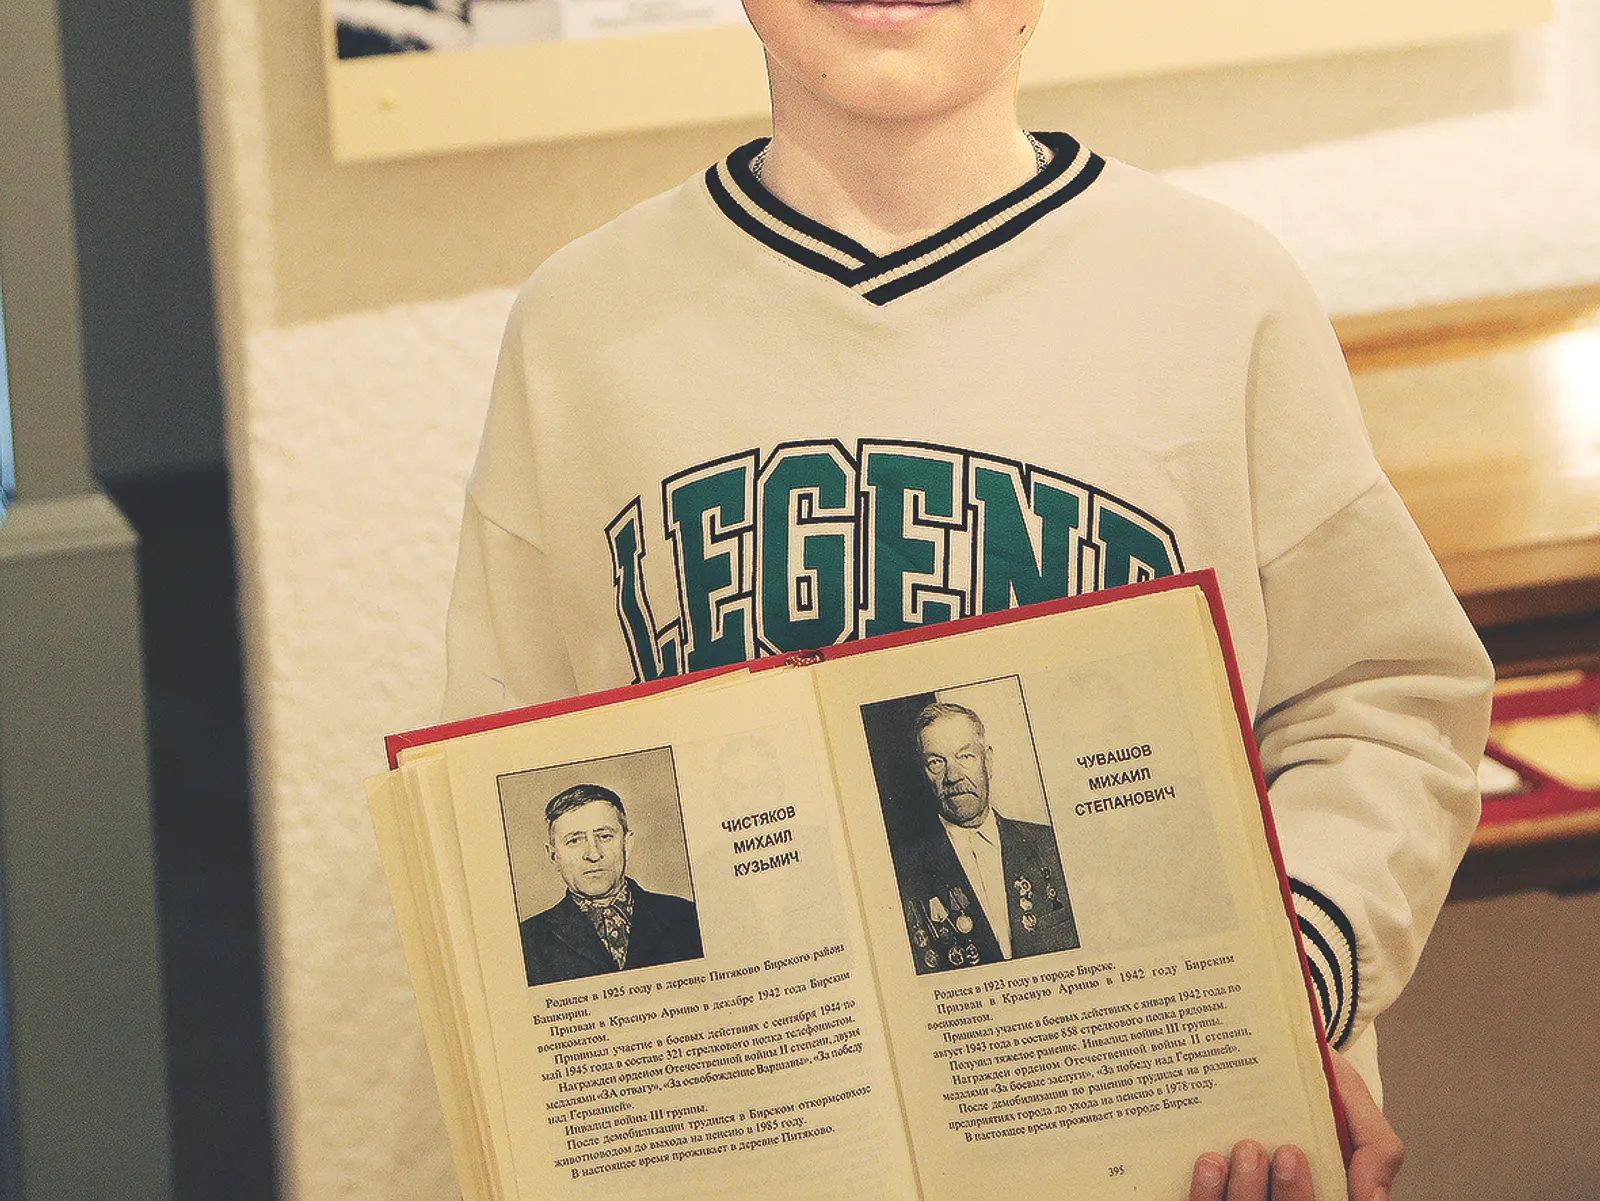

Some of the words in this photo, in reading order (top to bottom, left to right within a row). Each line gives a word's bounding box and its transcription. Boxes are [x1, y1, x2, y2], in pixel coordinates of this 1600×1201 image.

[1076, 744, 1153, 768] ЧУВАШОВ
[1088, 767, 1151, 790] МИХАИЛ
[721, 805, 796, 833] ЧИСТЯКОВ
[1074, 785, 1176, 816] СТЕПАНОВИЧ
[733, 829, 793, 854] МИХАИЛ
[733, 850, 800, 877] КУЗЬМИЧ
[545, 995, 589, 1008] Родился
[602, 986, 625, 999] 1925
[628, 984, 652, 995] году
[663, 976, 706, 989] деревне
[708, 965, 760, 981] Питяково
[763, 953, 810, 971] Бирского
[933, 987, 973, 1000] Родился
[983, 979, 1006, 992] 1923
[1007, 977, 1030, 988] году
[1039, 969, 1075, 983] городе
[1076, 962, 1116, 976] Бирске.
[936, 1000, 985, 1015] Призван
[999, 988, 1052, 1004] Красную
[1058, 980, 1099, 995] Армию
[1120, 969, 1145, 982] 1942
[1151, 965, 1177, 976] году
[1184, 955, 1235, 970] Бирским
[532, 1009, 591, 1025] Башкирии.
[549, 1022, 596, 1037] Призван
[608, 1011, 657, 1027] Красную
[660, 1004, 700, 1018] Армию
[712, 995, 754, 1010] декабре
[757, 987, 781, 1001] 1942
[783, 984, 807, 995] года
[809, 972, 850, 989] Бирским
[943, 1028, 994, 1043] Принимал
[994, 1021, 1034, 1037] участие
[1042, 1013, 1079, 1026] боевых
[1140, 995, 1177, 1009] января
[1178, 988, 1201, 1002] 1942
[1202, 987, 1227, 997] года
[1227, 984, 1242, 993] по
[553, 1048, 609, 1065] Принимал
[612, 1041, 655, 1057] участие
[663, 1032, 705, 1045] боевых
[770, 1009, 817, 1027] сентября
[841, 1000, 855, 1010] по
[932, 1047, 965, 1059] август
[988, 1040, 1012, 1050] года
[1020, 1031, 1060, 1045] составе
[1145, 1010, 1177, 1023] полка
[1178, 1002, 1227, 1019] рядовым.
[1129, 1027, 1164, 1040] войны
[1165, 1022, 1179, 1034] III
[541, 1069, 562, 1082] май
[564, 1064, 588, 1077] 1945
[589, 1062, 614, 1072] года
[623, 1053, 664, 1067] составе
[665, 1048, 683, 1060] 321
[751, 1033, 783, 1046] полка
[558, 1075, 617, 1092] Награжден
[618, 1068, 663, 1083] орденом
[664, 1053, 743, 1074] Отечественной
[744, 1049, 778, 1061] войны
[779, 1043, 788, 1055] II
[942, 1087, 989, 1101] медалями
[1154, 1056, 1174, 1066] над
[950, 1069, 1011, 1085] Награжден
[1014, 1061, 1063, 1076] орденом
[1063, 1044, 1147, 1066] Отечественной
[1150, 1038, 1186, 1052] войны
[1190, 1033, 1200, 1044] II
[545, 1094, 596, 1111] медалями
[681, 1068, 756, 1086] освобождение
[958, 1102, 988, 1113] После
[991, 1089, 1070, 1110] демобилизации
[1071, 1086, 1085, 1095] по
[1087, 1078, 1133, 1095] ранению
[1186, 1066, 1200, 1075] на
[1016, 1107, 1053, 1120] города
[1054, 1104, 1067, 1114] до
[1068, 1099, 1100, 1113] ухода
[1100, 1096, 1115, 1105] на
[1115, 1089, 1155, 1102] пенсию
[1188, 1079, 1217, 1089] году.
[545, 1114, 568, 1125] над
[566, 1137, 599, 1150] После
[603, 1123, 684, 1144] демобилизации
[748, 1104, 797, 1119] Бирском
[613, 1114, 648, 1126] войны
[648, 1109, 664, 1120] III
[632, 1143, 648, 1153] до
[649, 1137, 689, 1149] выхода
[689, 1134, 703, 1143] на
[704, 1128, 744, 1140] пенсию
[755, 1119, 778, 1132] 1985
[780, 1117, 807, 1131] году.
[974, 1126, 1025, 1141] настоящее
[1027, 1121, 1057, 1134] время
[1058, 1111, 1115, 1129] проживает
[1115, 1109, 1124, 1118] в
[1124, 1103, 1160, 1117] городе
[1162, 1096, 1202, 1109] Бирске.
[581, 1160, 637, 1176] настоящее
[638, 1154, 669, 1167] время
[671, 1144, 729, 1161] проживает
[738, 1135, 780, 1151] деревне
[780, 1125, 835, 1142] Питяково.
[1108, 1164, 1125, 1177] 395
